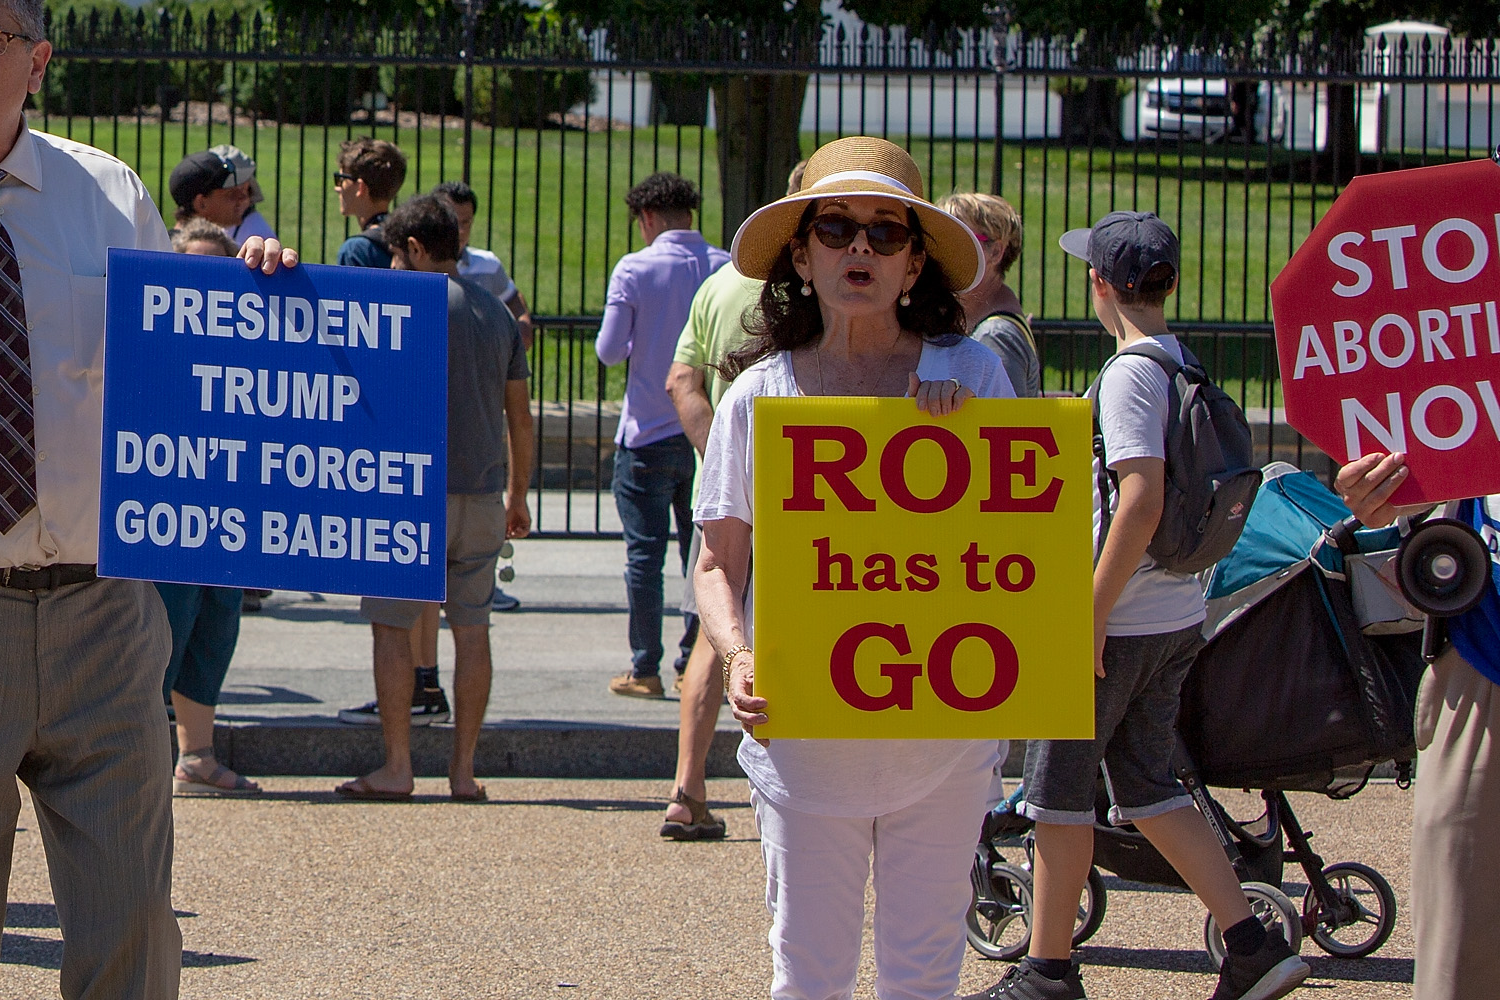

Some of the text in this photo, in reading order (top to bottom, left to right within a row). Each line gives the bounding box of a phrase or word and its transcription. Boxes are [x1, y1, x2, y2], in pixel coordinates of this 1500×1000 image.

[1327, 213, 1500, 298] STO
[142, 284, 411, 351] PRESIDENT
[192, 364, 361, 422] TRUMP
[116, 431, 432, 496] DON'T FORGET
[782, 424, 1065, 514] ROE
[115, 499, 430, 566] GOD'S BABIES!
[812, 536, 1036, 592] has to
[829, 622, 1020, 712] GO
